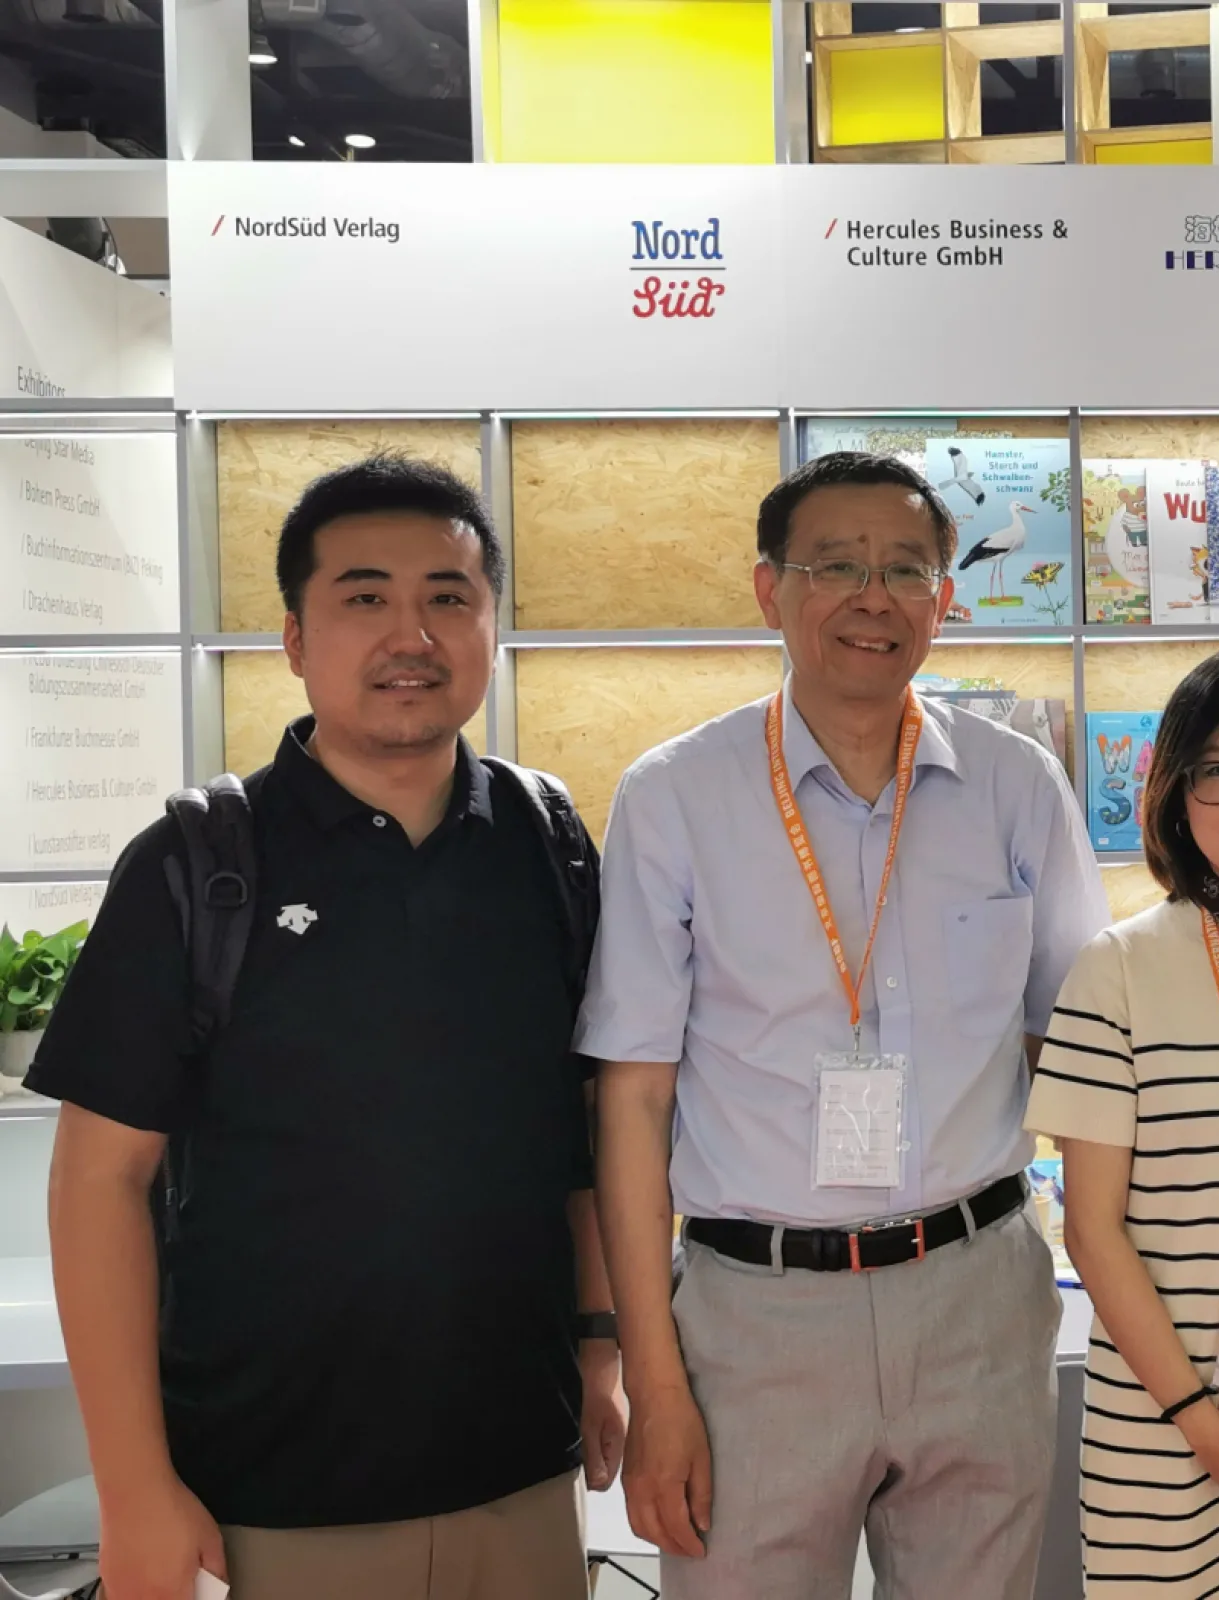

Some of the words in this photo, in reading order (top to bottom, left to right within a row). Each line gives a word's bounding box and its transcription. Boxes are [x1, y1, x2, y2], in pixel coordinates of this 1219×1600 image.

[234, 216, 327, 237] NordSüd
[333, 217, 401, 243] Verlag
[630, 217, 724, 260] Nord
[846, 219, 941, 239] Hercules
[950, 219, 1044, 239] Business
[1052, 219, 1069, 239] &
[846, 245, 928, 266] Culture
[936, 245, 1004, 266] GmbH
[632, 275, 726, 318] Süd
[1021, 461, 1039, 470] und
[995, 484, 1034, 493] schwanz
[1163, 491, 1208, 524] Wu
